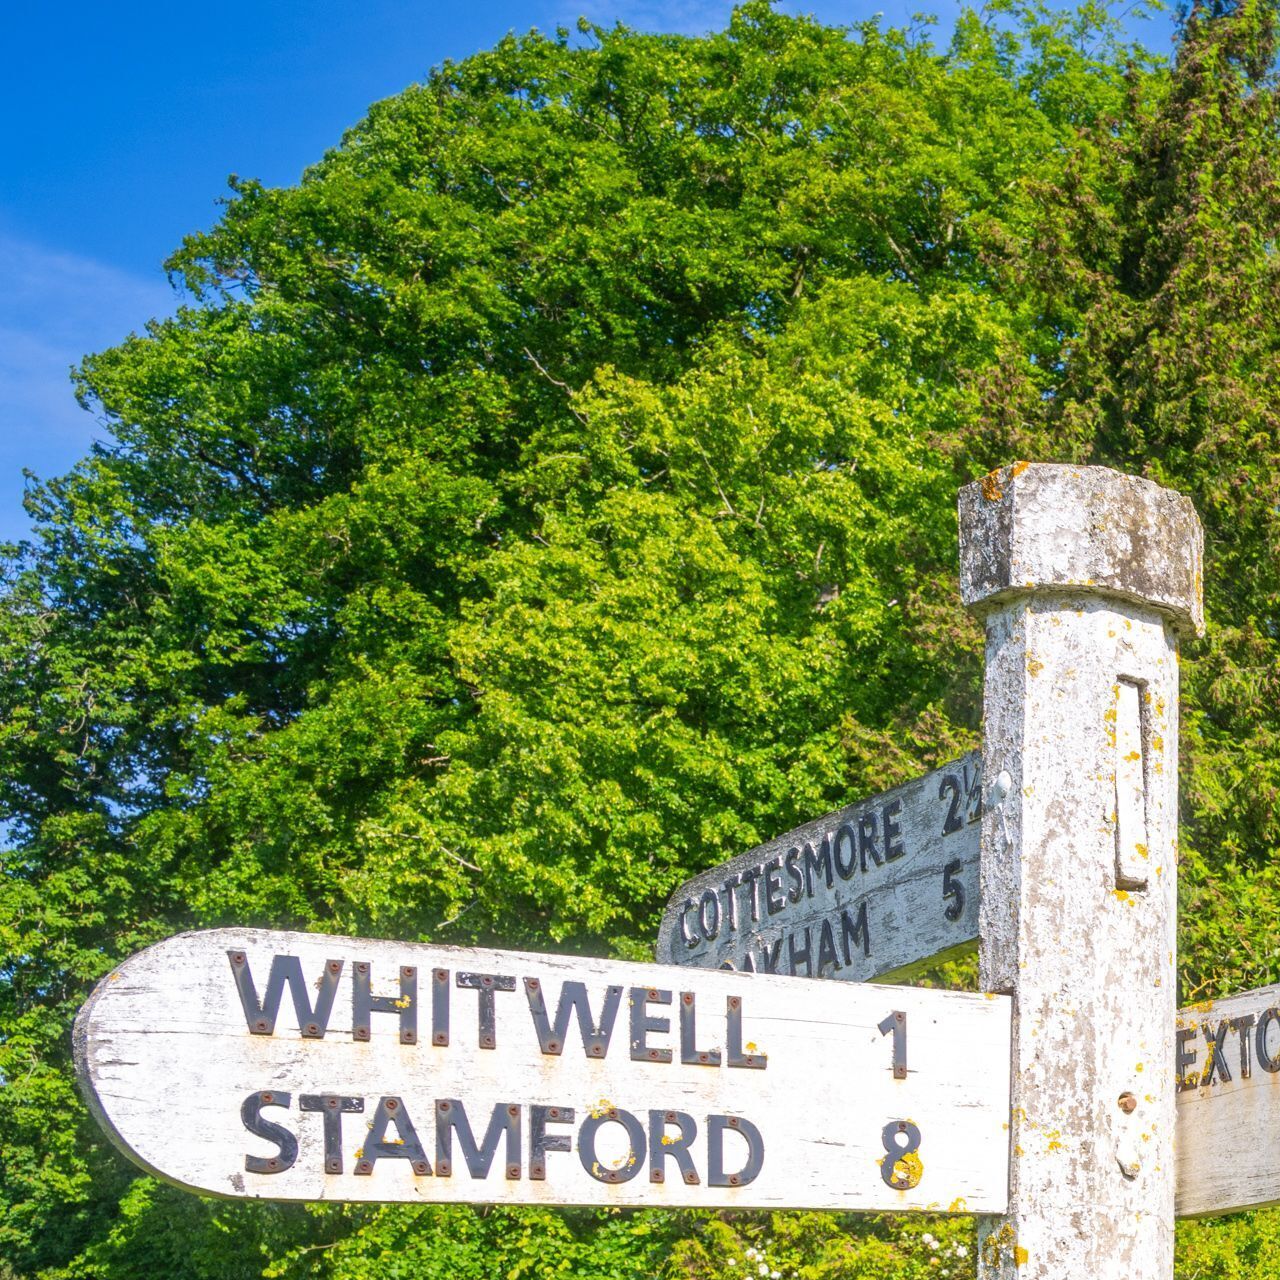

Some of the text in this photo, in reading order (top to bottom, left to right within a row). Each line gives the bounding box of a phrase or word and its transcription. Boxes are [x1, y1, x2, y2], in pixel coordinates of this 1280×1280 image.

[680, 799, 905, 949] COTTESMORE
[719, 858, 967, 979] KHAM 5
[226, 950, 908, 1080] WHITWELL 1
[241, 1090, 923, 1190] STAMFORD 8
